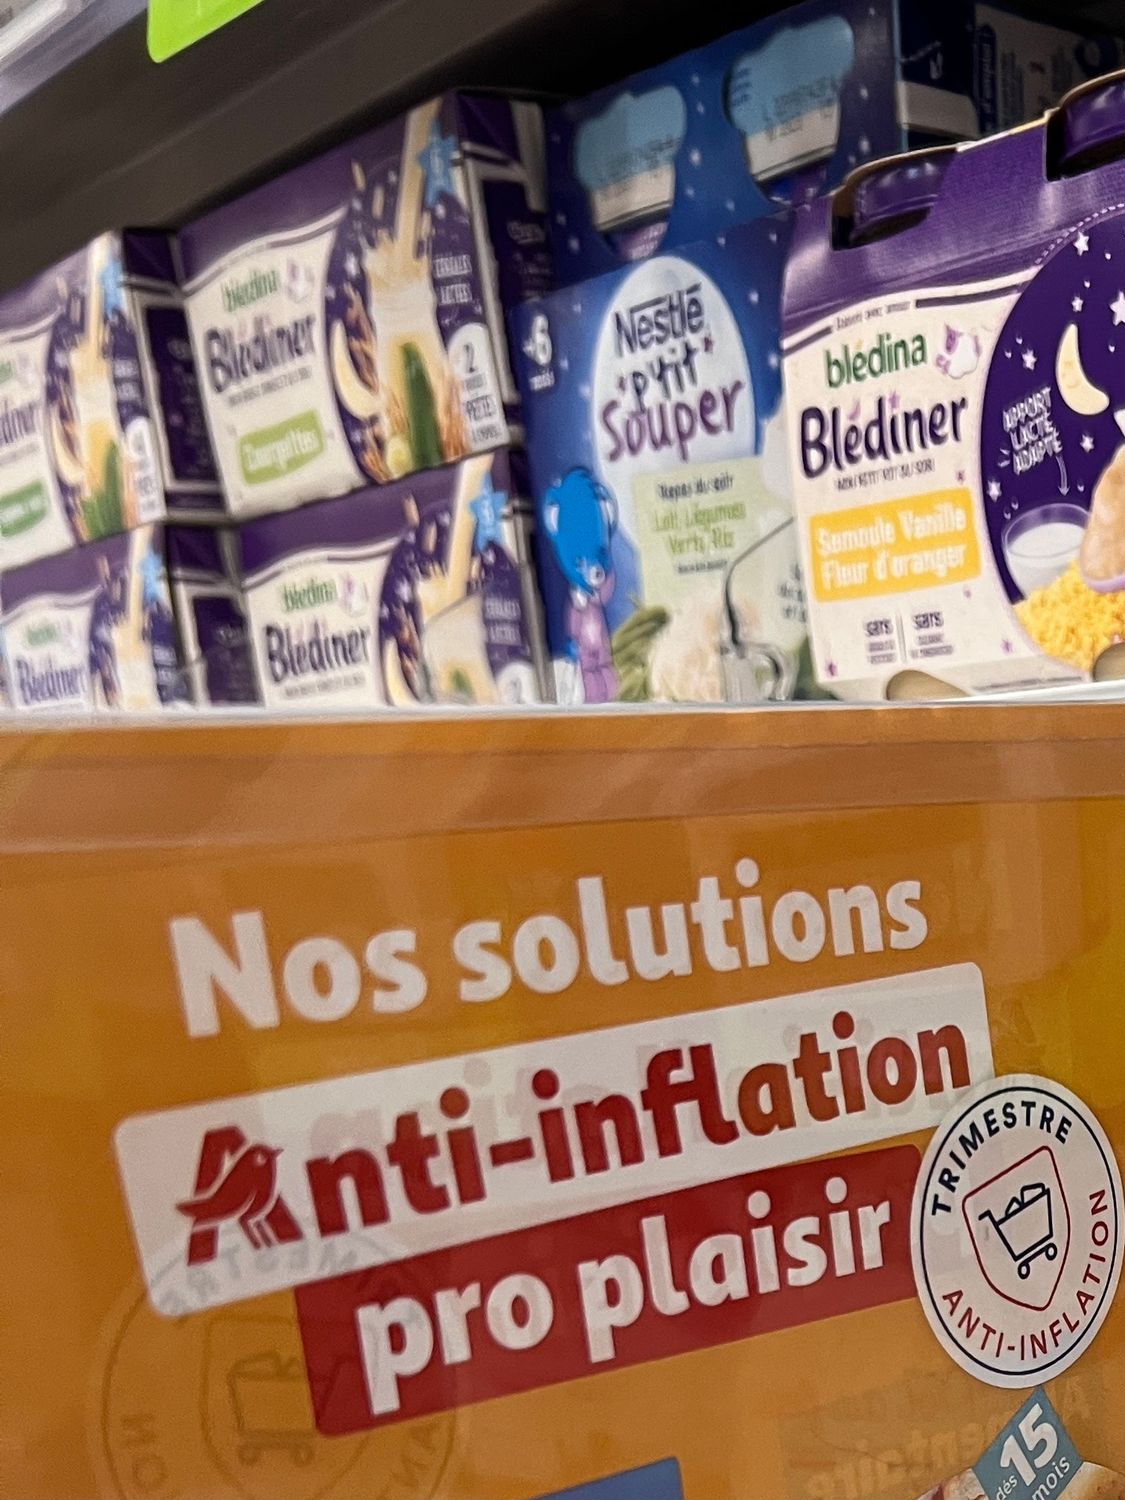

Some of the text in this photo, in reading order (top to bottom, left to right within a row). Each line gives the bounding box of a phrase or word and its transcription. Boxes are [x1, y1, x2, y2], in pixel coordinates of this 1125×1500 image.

[615, 281, 705, 357] Nestlé
[602, 380, 744, 461] Souper
[801, 395, 968, 480] Blédiner
[169, 857, 928, 1038] Nos solutions
[176, 1010, 971, 1267] Anti-inflation
[932, 1101, 1072, 1217] TRIMESTRE
[356, 1176, 891, 1417] pro plaisir
[942, 1188, 1107, 1362] ANTI-INFLATION
[1000, 1403, 1058, 1487] 15
